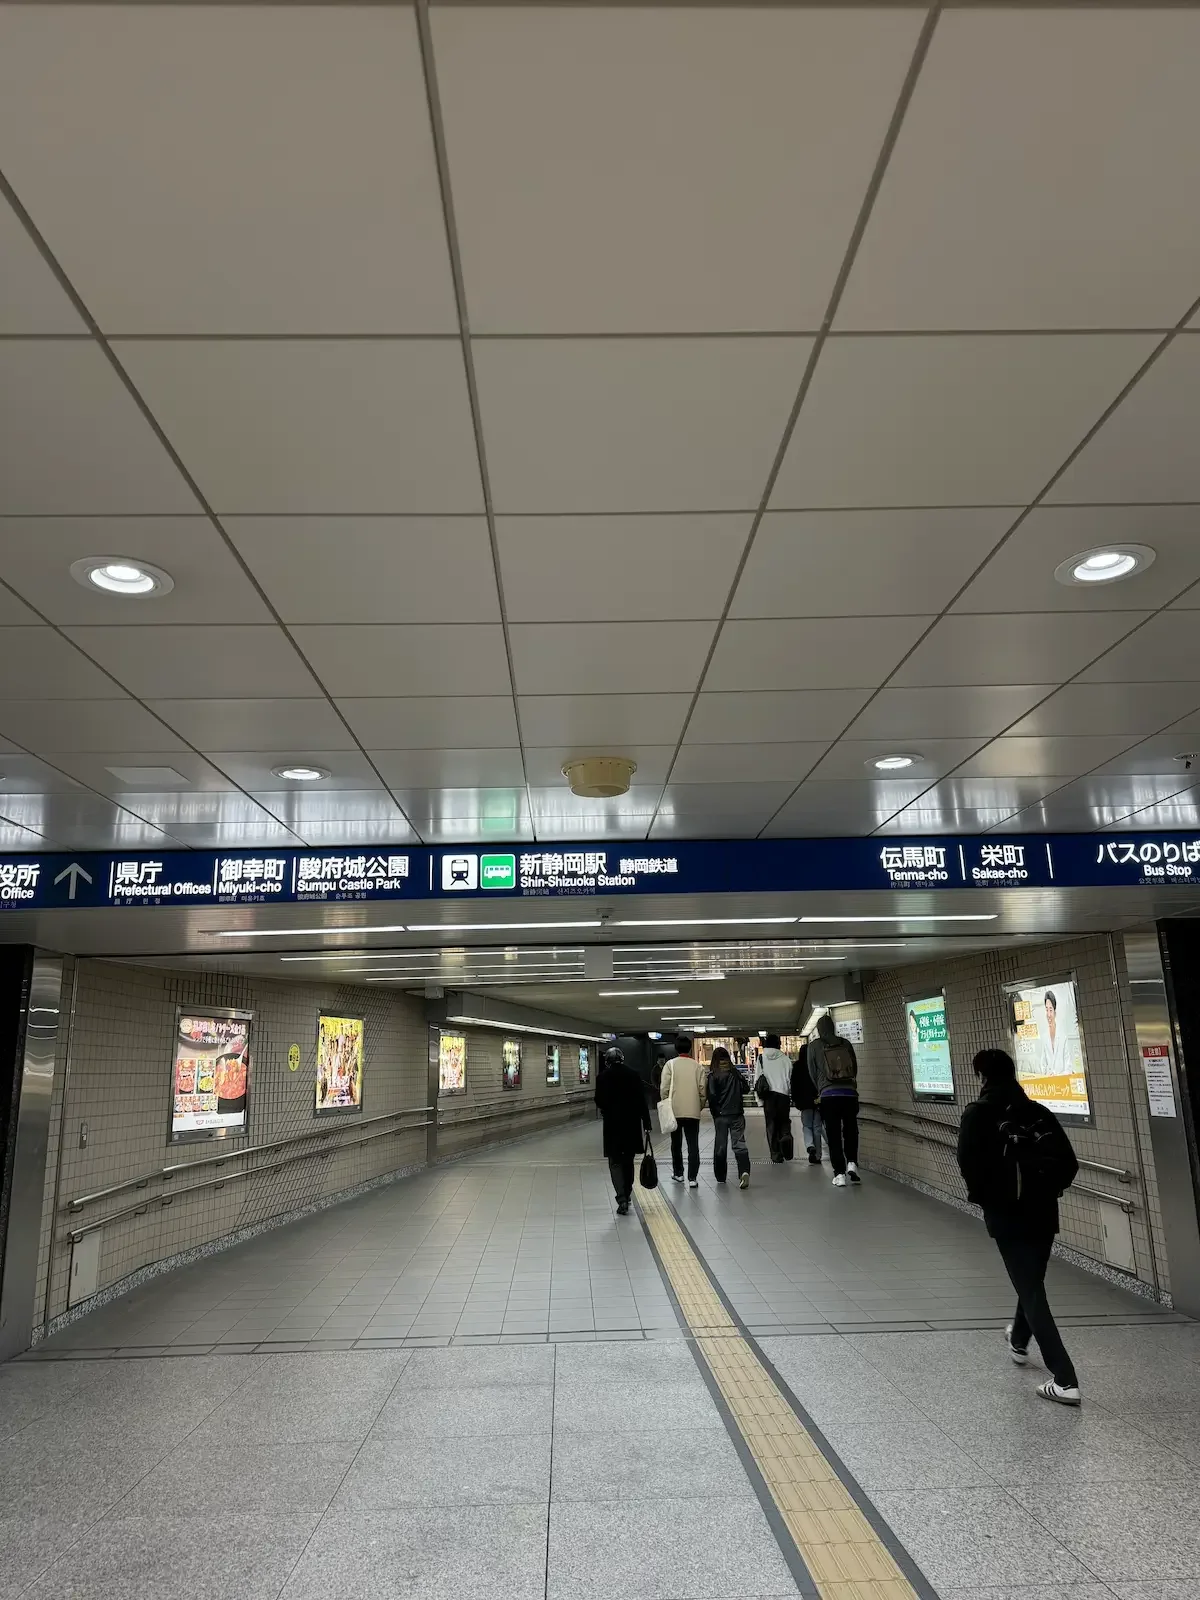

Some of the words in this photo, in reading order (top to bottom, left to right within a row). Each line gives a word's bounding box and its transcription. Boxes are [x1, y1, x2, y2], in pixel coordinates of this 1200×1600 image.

[519, 852, 607, 875] 新静岡駅
[619, 857, 678, 874] 静岡鉄道
[880, 846, 946, 869] 伝馬町
[981, 845, 1024, 867] 栄町
[115, 861, 163, 884] 県庁
[220, 858, 286, 882] 御幸町
[298, 855, 409, 880] 駿府城公園
[887, 869, 948, 881] Tenma-cho
[972, 867, 1028, 879] Sakae-cho
[1144, 864, 1165, 876] Bus
[1166, 864, 1192, 877] Stop
[114, 883, 171, 896] Prefectural
[173, 882, 211, 895] Offices
[218, 880, 282, 896] Miyuki-cho
[297, 879, 336, 893] Sumpu
[339, 877, 373, 890] Castle
[376, 877, 400, 889] Park
[520, 875, 595, 888] Shin-Shizuoka
[598, 874, 635, 886] Station
[1, 886, 34, 899] Office
